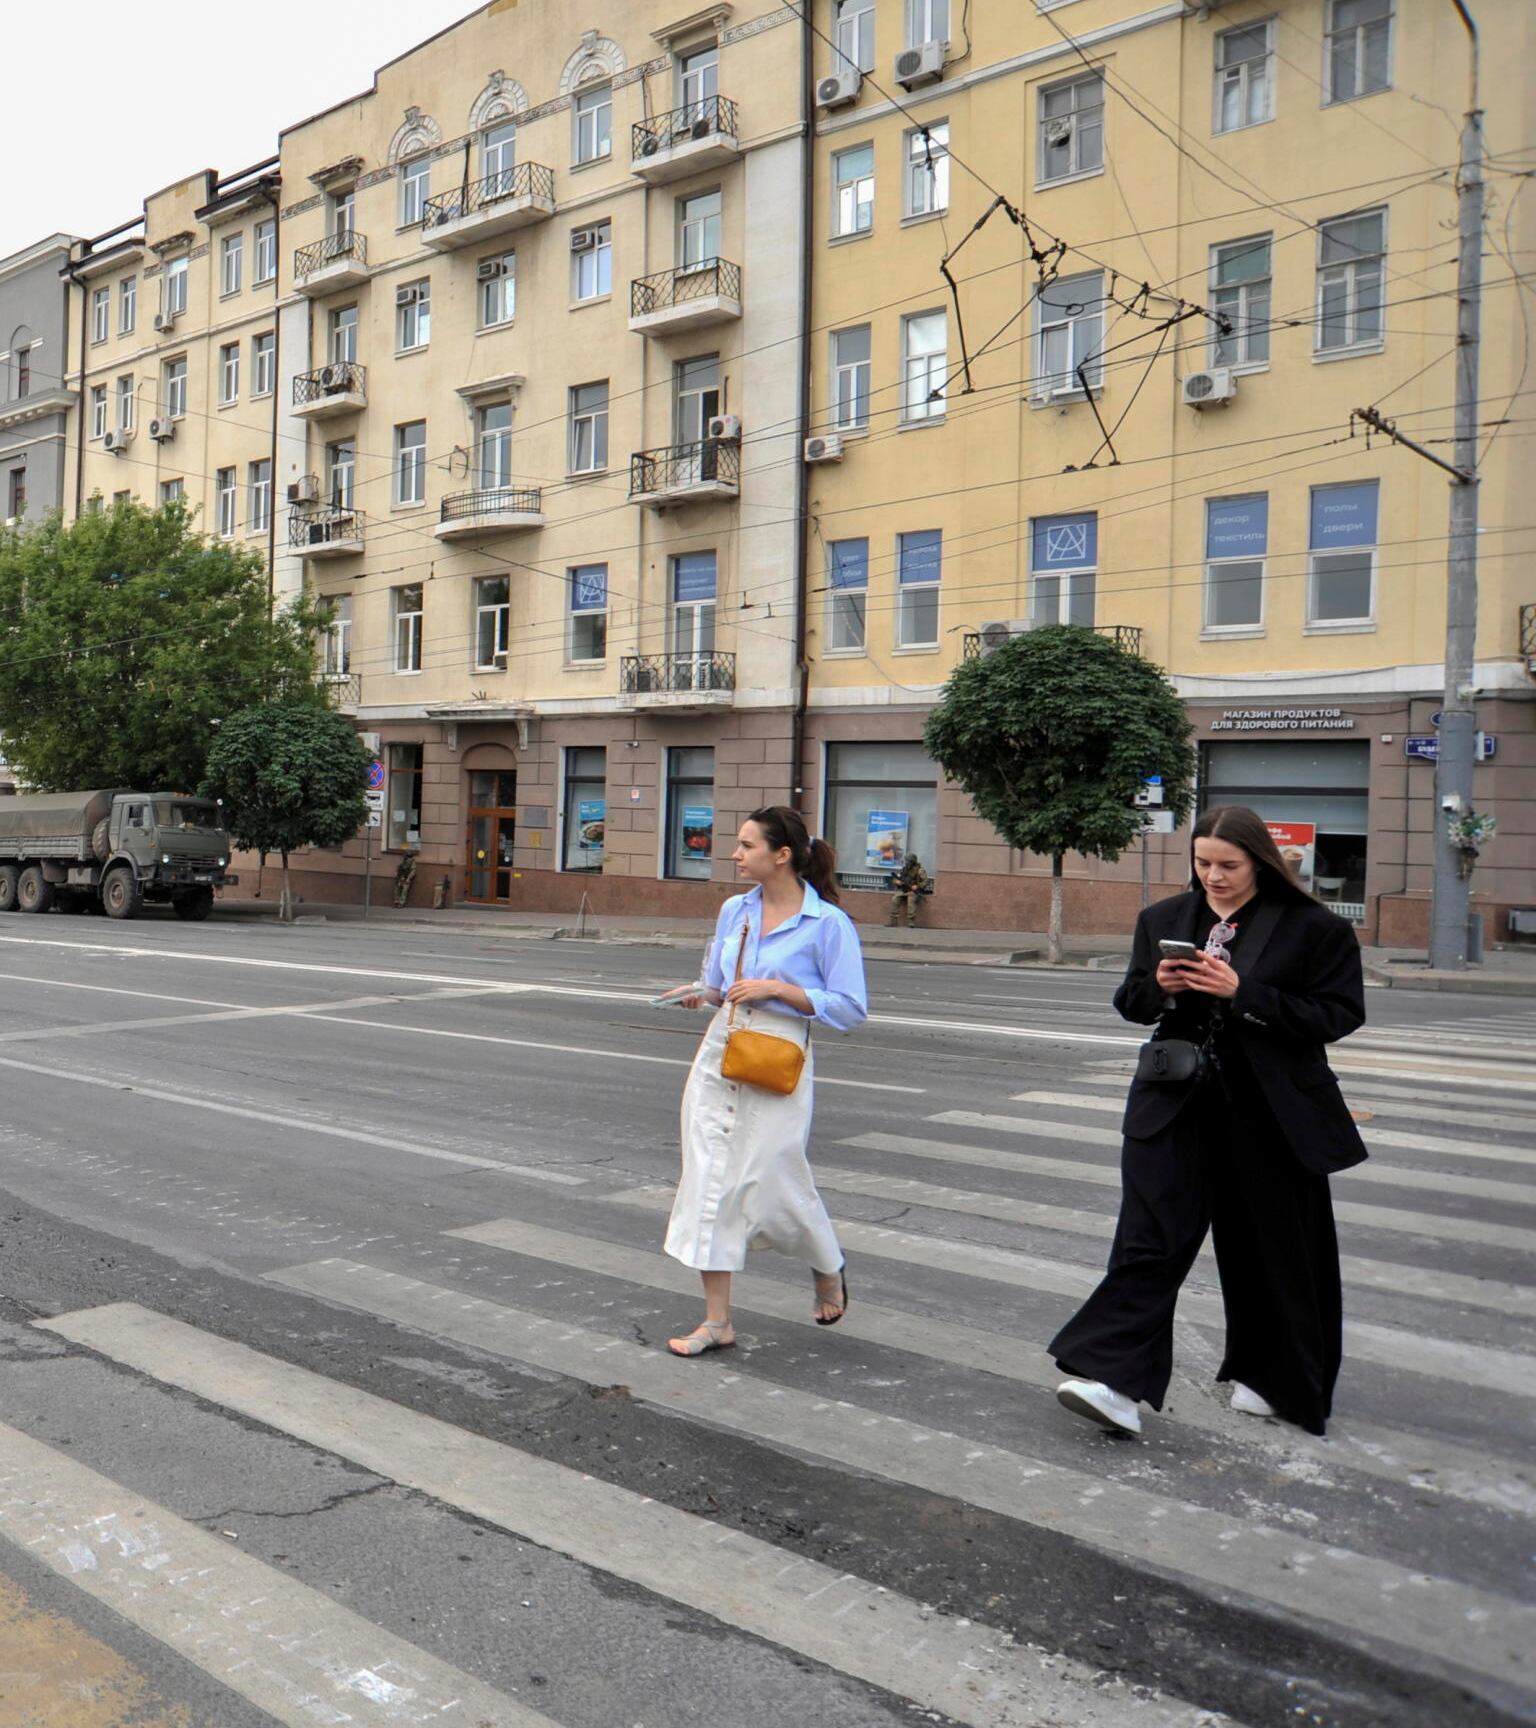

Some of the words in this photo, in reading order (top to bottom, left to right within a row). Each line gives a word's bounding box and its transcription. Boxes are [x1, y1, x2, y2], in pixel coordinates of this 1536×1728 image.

[1213, 514, 1251, 526] декор
[1322, 522, 1364, 534] двери
[1223, 710, 1272, 719] МАГАЗИН
[1274, 708, 1341, 719] ПРОДУКТОВ
[1210, 720, 1233, 730] ДЛЯ
[1235, 719, 1298, 730] ЗДОРОВОГО
[1301, 719, 1354, 729] ПИТАНИЯ
